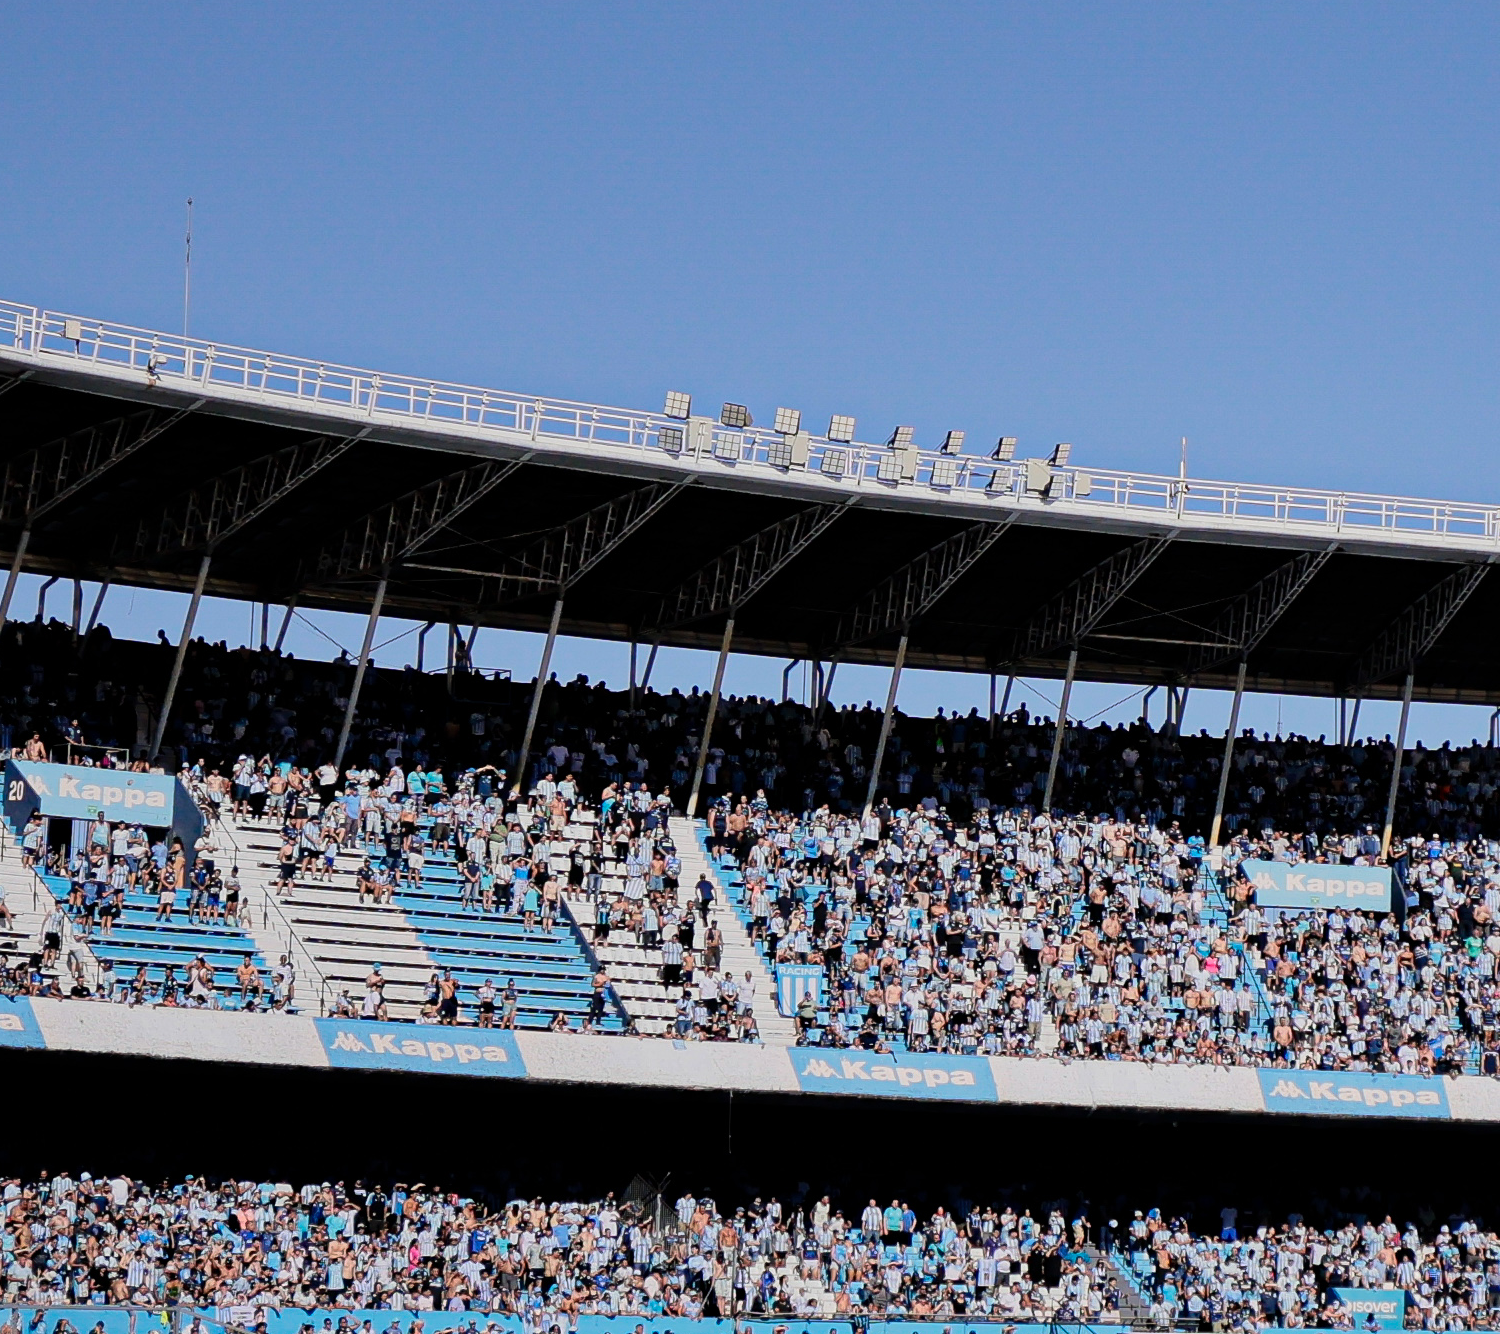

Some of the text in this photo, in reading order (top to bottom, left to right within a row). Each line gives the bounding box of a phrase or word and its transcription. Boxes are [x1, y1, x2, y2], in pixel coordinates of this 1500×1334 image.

[8, 780, 25, 801] 20
[59, 777, 165, 808] Kappa
[1286, 873, 1385, 898] Kappa
[779, 966, 820, 976] RACING
[370, 1033, 508, 1064] Kappa
[840, 1060, 976, 1088] Kappa
[1309, 1081, 1441, 1107] Kappa
